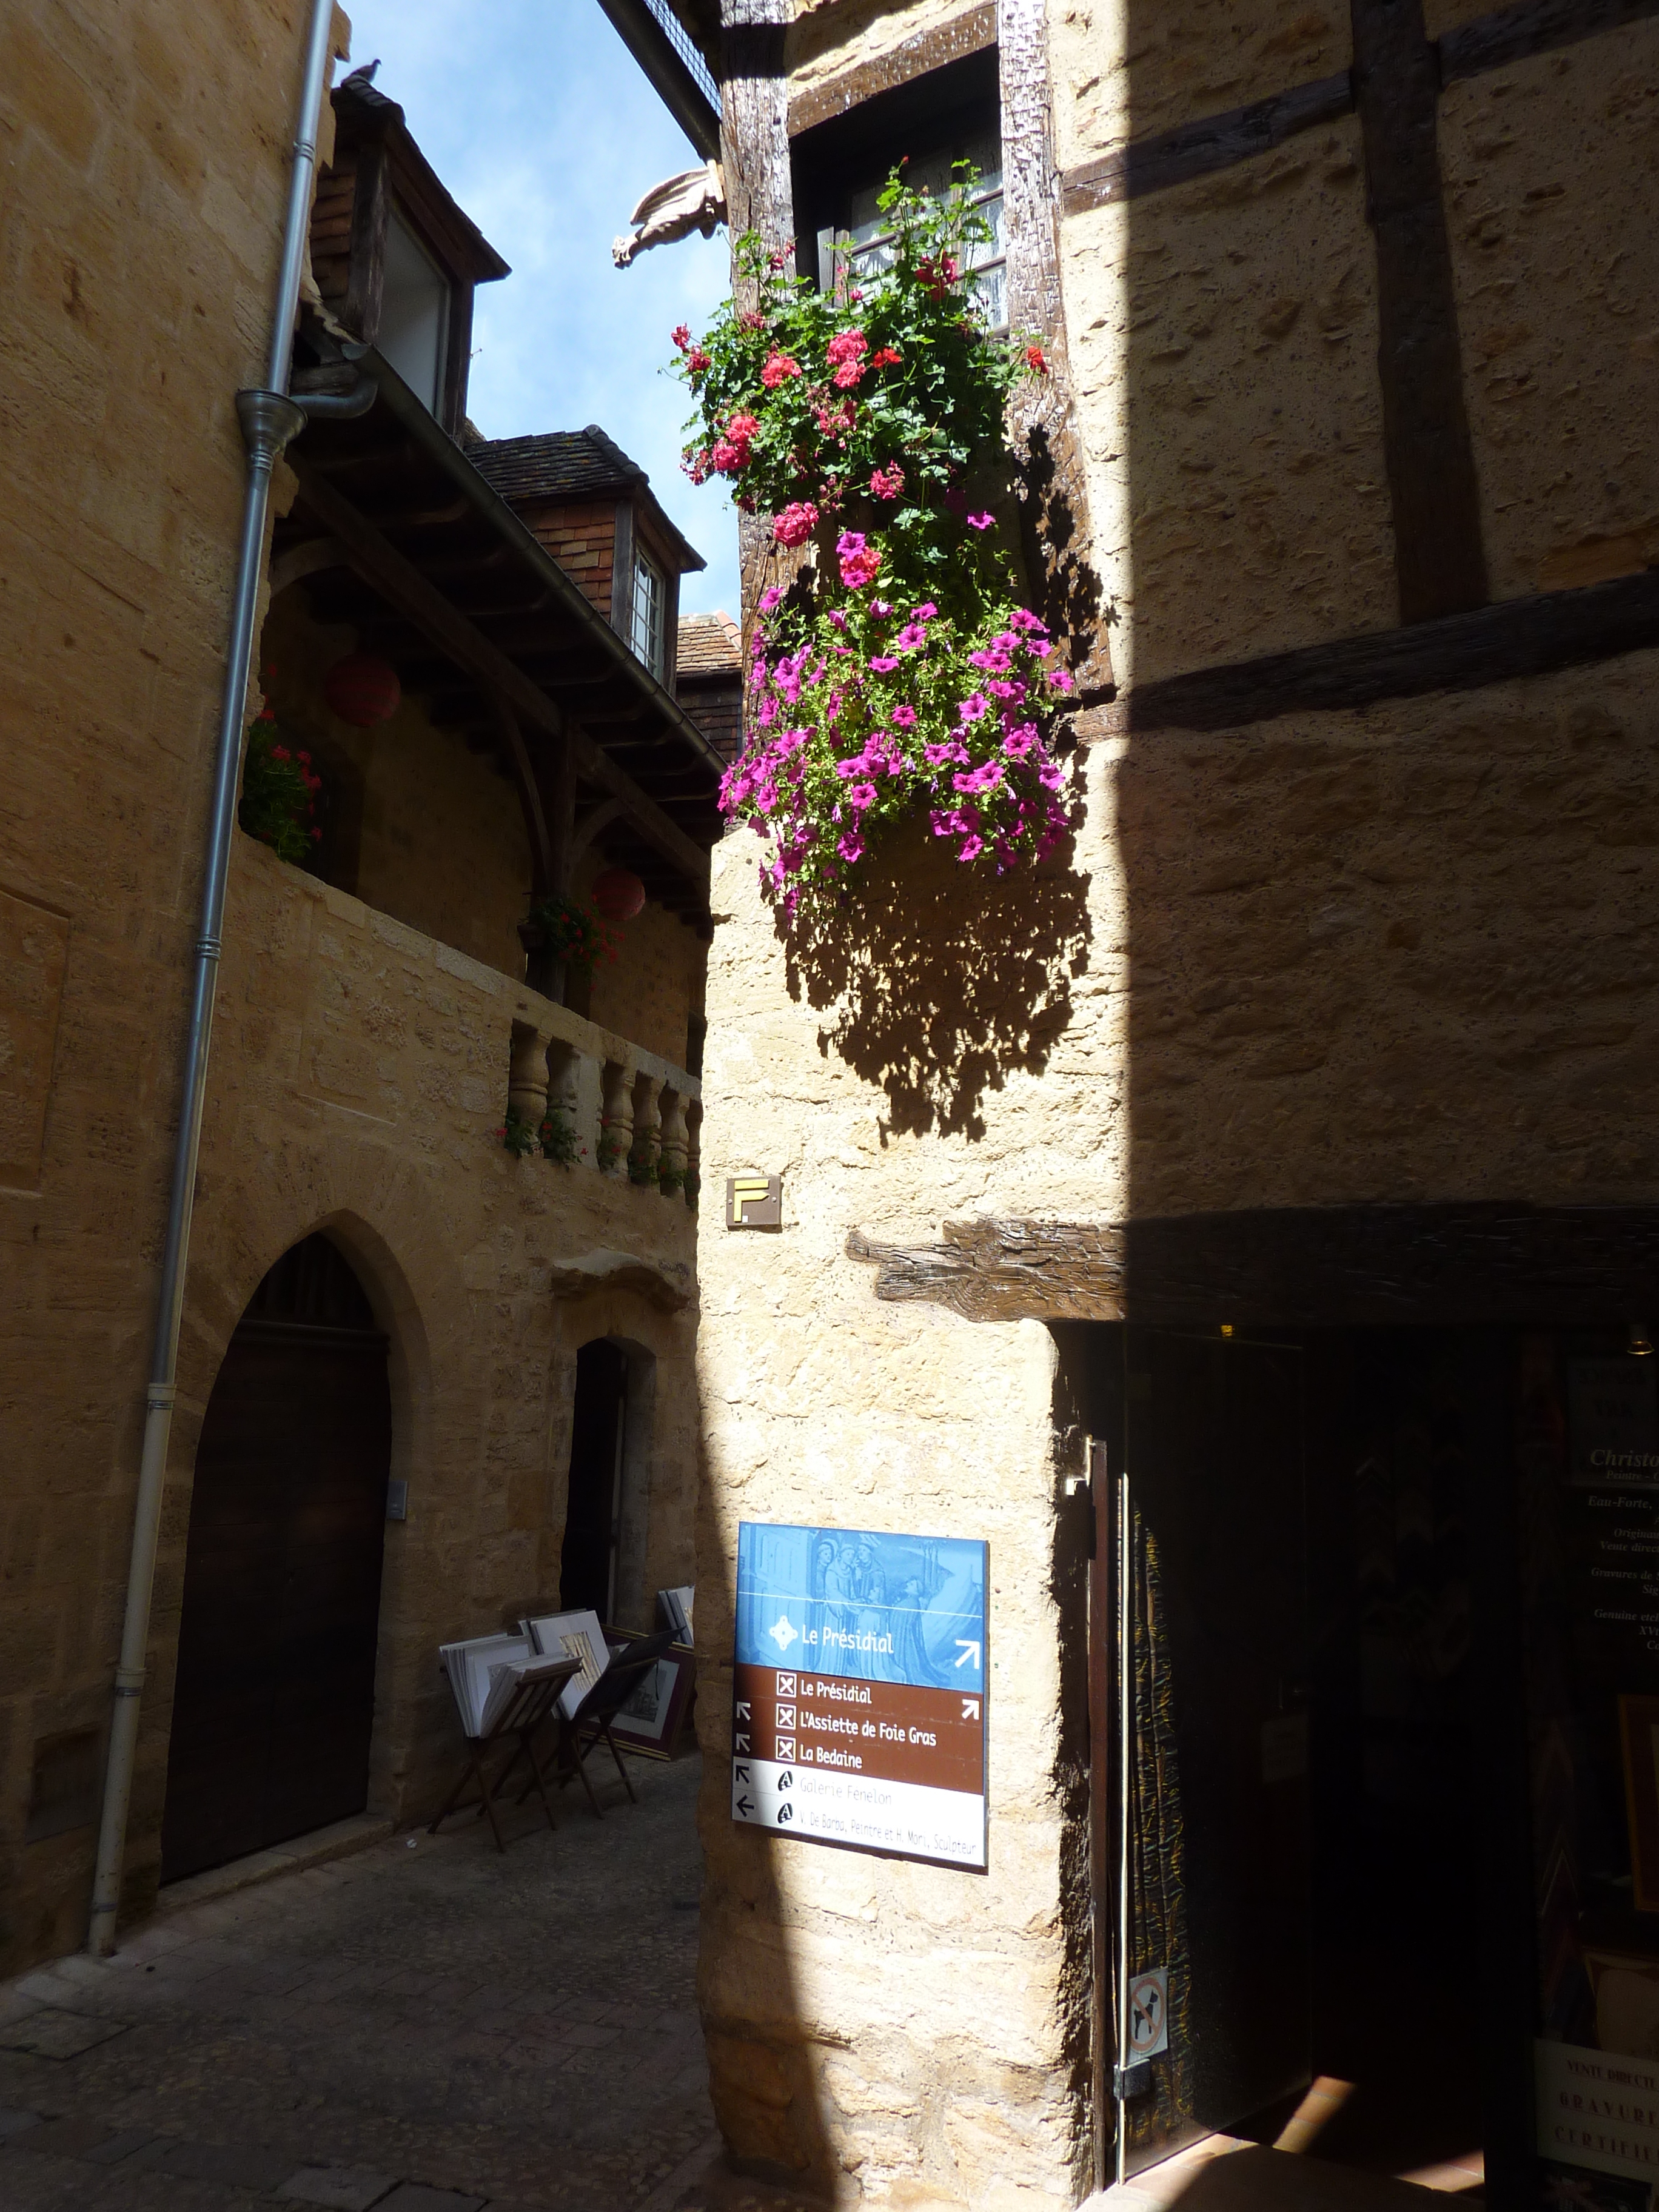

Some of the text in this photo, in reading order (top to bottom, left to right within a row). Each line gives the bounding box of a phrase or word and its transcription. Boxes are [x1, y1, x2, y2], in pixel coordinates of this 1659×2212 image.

[1588, 1495, 1652, 1510] Eau-Forte,
[1600, 1540, 1628, 1552] Vente
[1591, 1567, 1638, 1580] Gravures
[1640, 1570, 1653, 1580] de
[1594, 1608, 1638, 1621] Genuine
[802, 1624, 894, 1654] Le Présidial
[801, 1679, 872, 1704] Le Présidial
[800, 1711, 937, 1746] L'Assiette de Foie Gras
[800, 1744, 862, 1769] La Bedaine
[800, 1777, 892, 1806] Galerie Fénelon
[810, 1811, 820, 1827] De
[822, 1814, 848, 1834] Barba,
[851, 1819, 882, 1839] Peintre
[885, 1827, 893, 1842] et
[897, 1827, 904, 1843] H.
[907, 1829, 930, 1851] Mori,
[934, 1834, 977, 1856] Sculpteur
[1555, 2126, 1659, 2162] CERTIFIE
